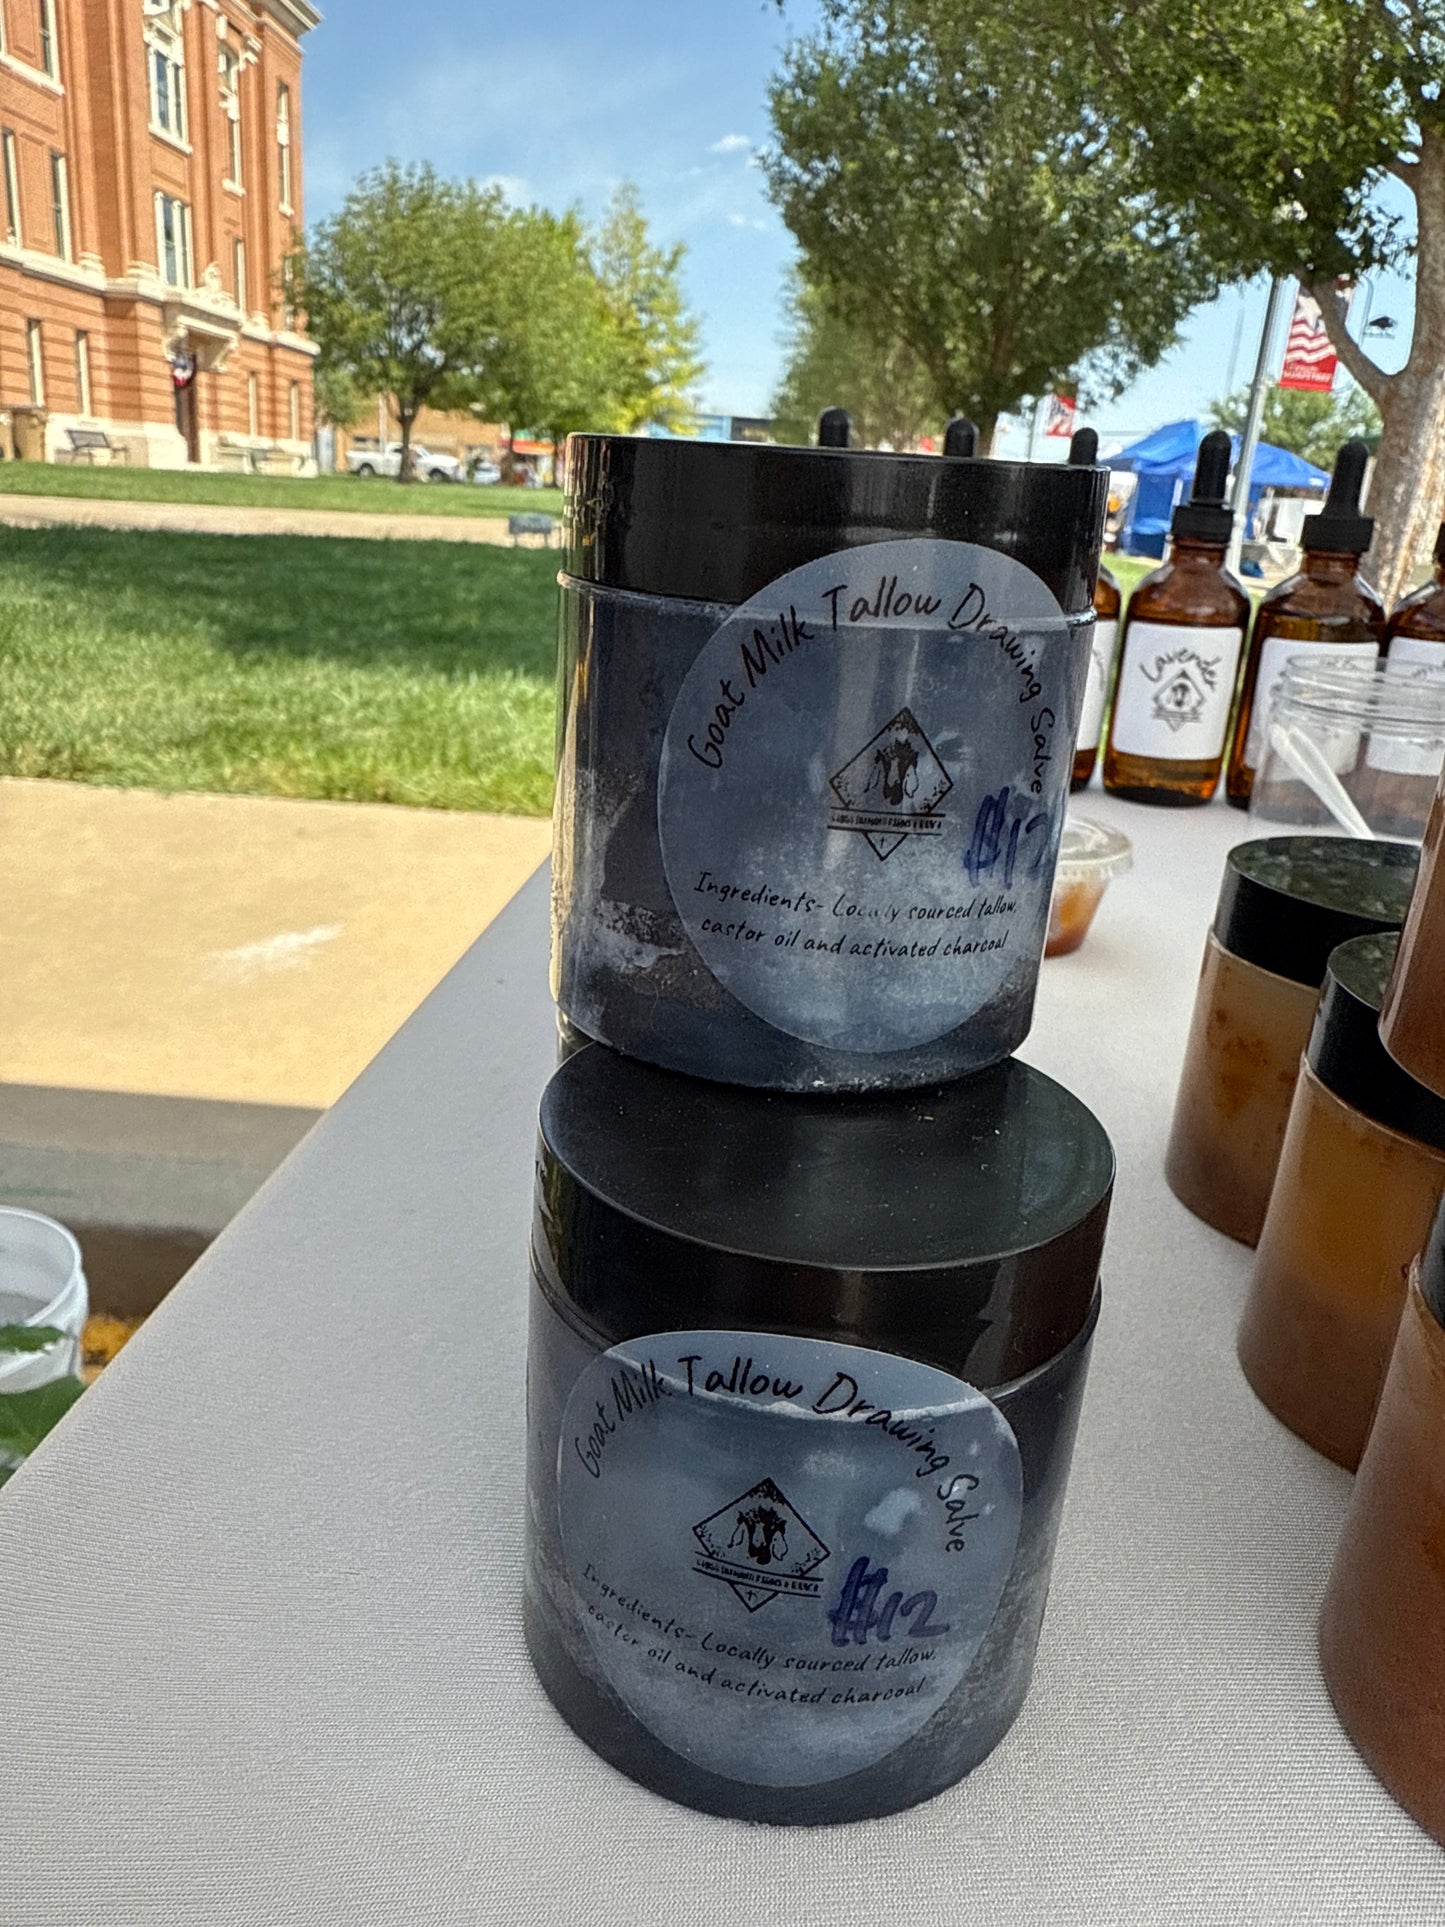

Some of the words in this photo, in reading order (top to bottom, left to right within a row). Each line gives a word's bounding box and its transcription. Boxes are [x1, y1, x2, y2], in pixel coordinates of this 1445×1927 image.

[687, 679, 746, 770] Goat
[740, 605, 815, 689] Milk
[821, 575, 942, 632] Tallow
[947, 582, 1043, 704] Drawing
[1030, 707, 1057, 795] Salve
[1139, 647, 1222, 692] Lavender
[694, 871, 825, 913] Ingredients-
[832, 894, 899, 924] Localy
[909, 898, 977, 920] sourced
[701, 918, 764, 942] castor
[774, 928, 801, 947] oil
[804, 934, 847, 955] and
[849, 937, 942, 958] activated
[943, 929, 1010, 957] charcoal
[575, 1400, 616, 1479] Goat
[611, 1358, 673, 1422] Milk
[677, 1355, 804, 1397] Tallow
[811, 1371, 951, 1478] Drawing
[936, 1473, 980, 1554] Salve
[588, 1604, 639, 1646] castor
[647, 1648, 672, 1664] oil
[674, 1661, 717, 1685] and
[720, 1678, 828, 1705] activated
[830, 1675, 928, 1705] charcoal
[701, 1632, 777, 1670] Locally
[783, 1653, 872, 1673] sourced
